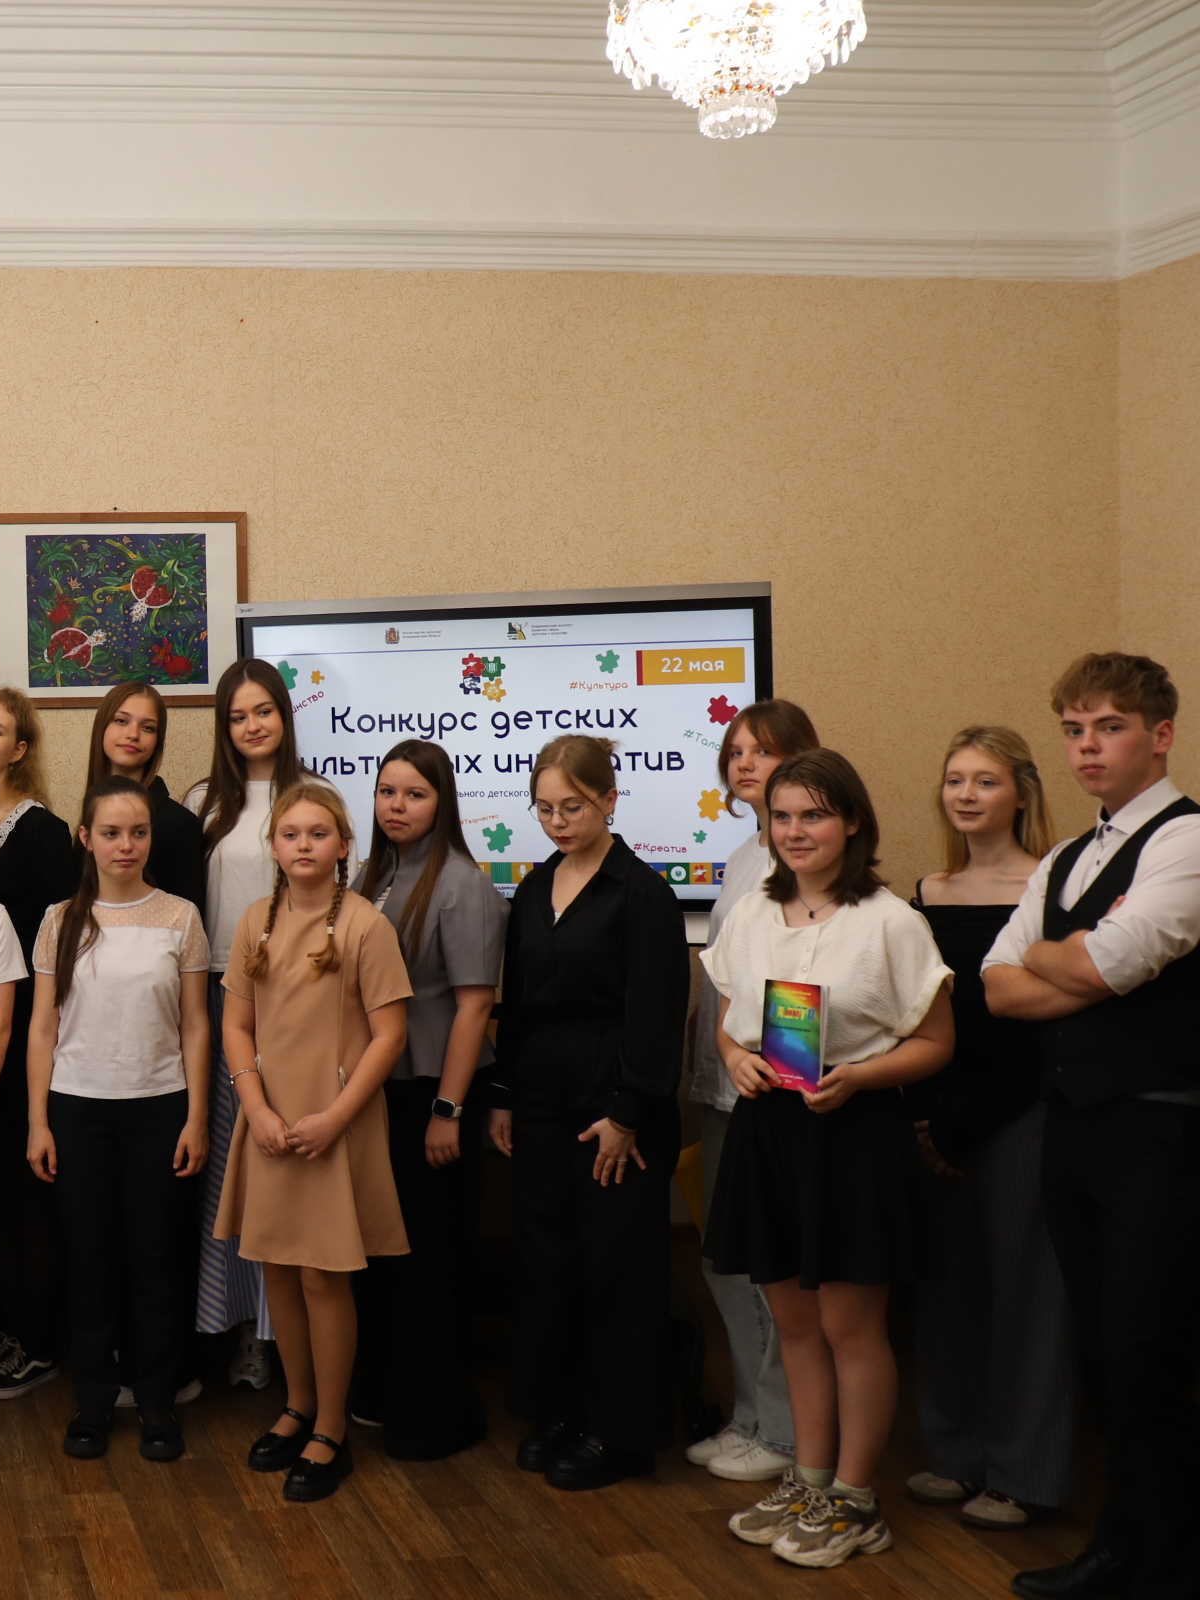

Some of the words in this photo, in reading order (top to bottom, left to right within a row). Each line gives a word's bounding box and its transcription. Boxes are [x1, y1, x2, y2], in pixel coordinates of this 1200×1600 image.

[661, 657, 683, 673] 22
[689, 660, 725, 672] мая
[569, 681, 628, 691] #Культура
[292, 691, 325, 714] инство
[331, 706, 478, 740] Конкурс
[490, 708, 638, 739] детских
[683, 729, 722, 752] #Тала
[488, 790, 530, 799] детского
[633, 843, 687, 853] #Креатив
